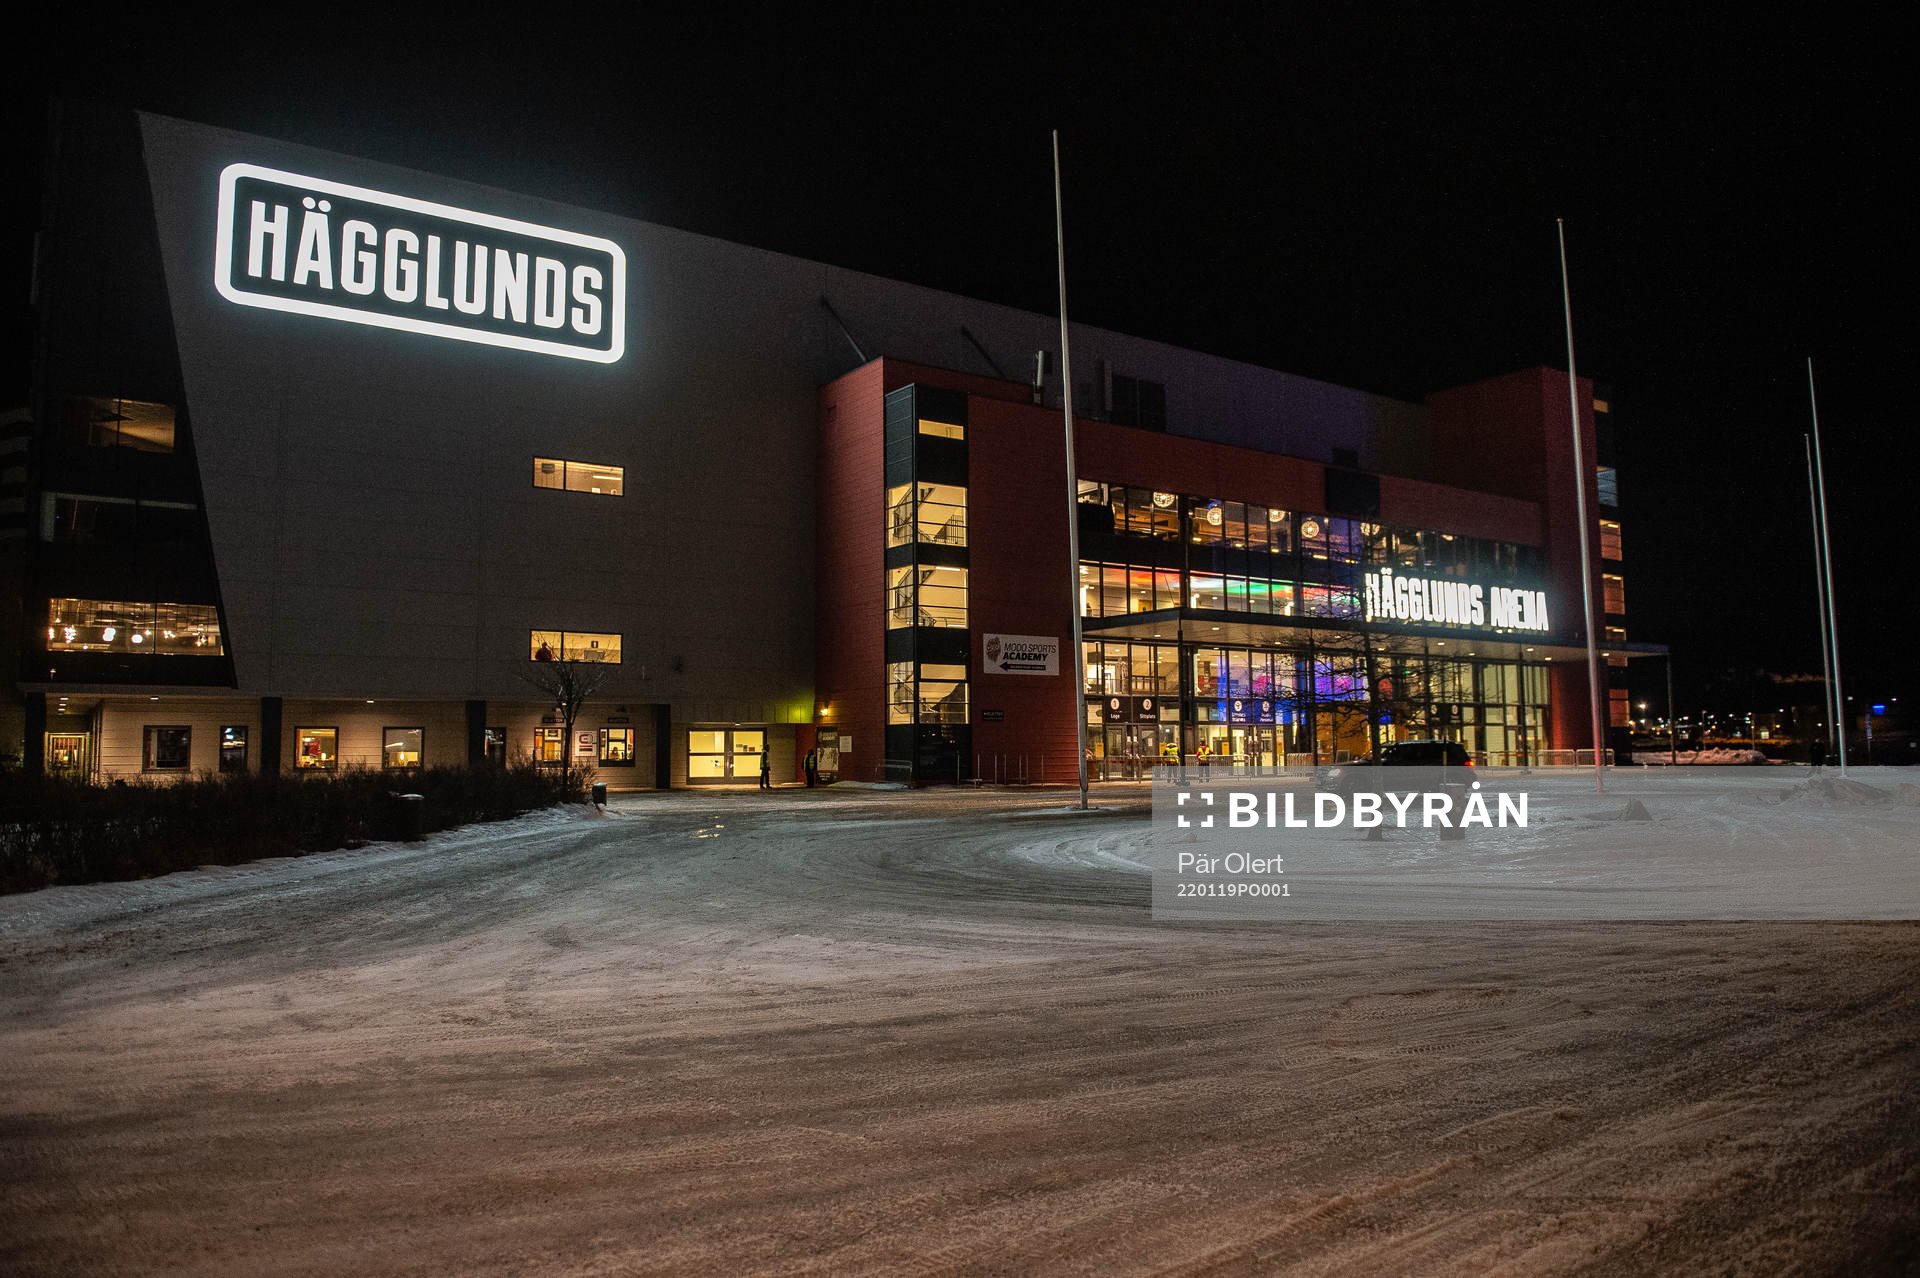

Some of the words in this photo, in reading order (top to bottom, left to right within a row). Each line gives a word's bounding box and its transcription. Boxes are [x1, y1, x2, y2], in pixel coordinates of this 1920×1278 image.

[247, 196, 603, 336] HÄGGLUNDS
[1364, 566, 1485, 626] HÄGGLUNDS
[1490, 586, 1550, 632] ARENA
[1003, 652, 1049, 661] ACADEMY
[1029, 644, 1057, 654] SPORTS
